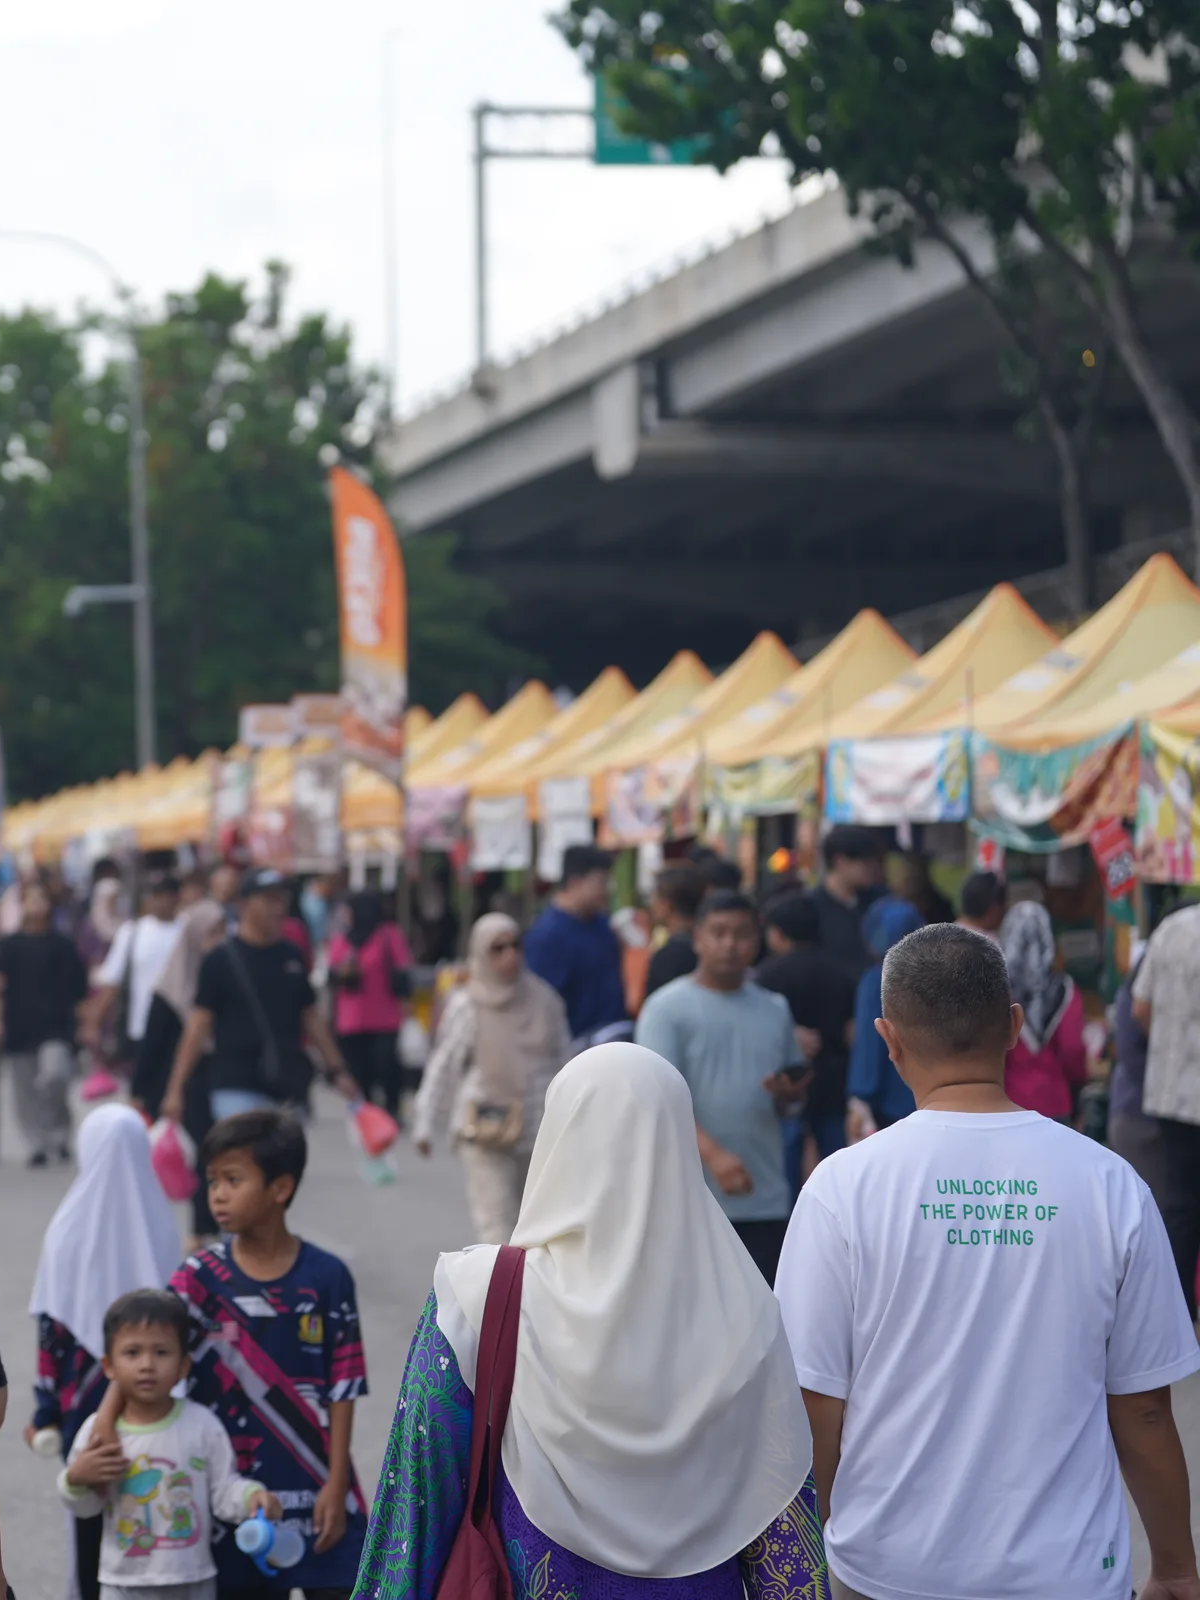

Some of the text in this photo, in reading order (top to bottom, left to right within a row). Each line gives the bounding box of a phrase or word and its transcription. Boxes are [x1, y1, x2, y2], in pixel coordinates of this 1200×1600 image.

[936, 1179, 1038, 1196] UNLOCKING
[919, 1203, 1059, 1222] THE POWER OF
[946, 1228, 1035, 1246] CLOTHING
